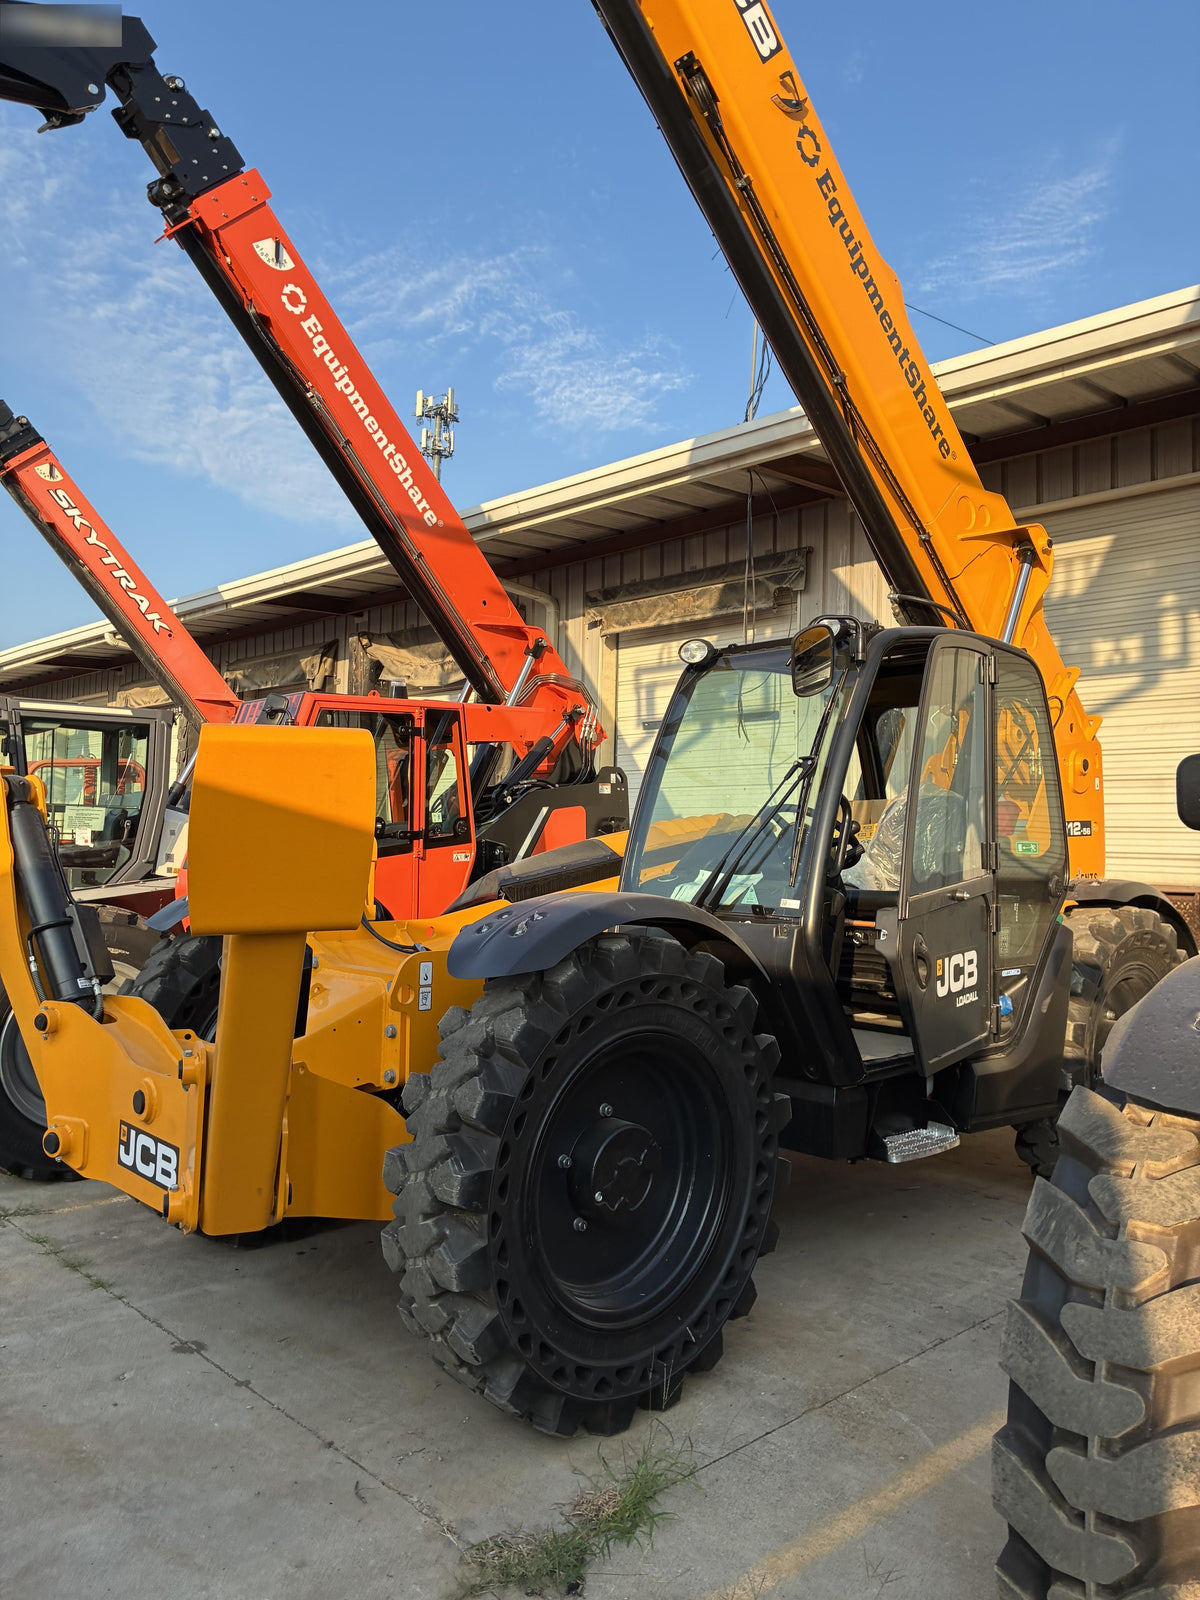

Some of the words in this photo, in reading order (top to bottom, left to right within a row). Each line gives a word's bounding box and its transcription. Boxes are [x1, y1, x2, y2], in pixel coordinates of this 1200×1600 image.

[816, 168, 951, 459] EquipmentShare
[300, 314, 438, 527] EquipmentShare
[47, 488, 173, 635] SKYTRAK
[936, 949, 978, 998] JCB
[956, 990, 979, 1008] LOADALL
[119, 1128, 178, 1189] JCB
